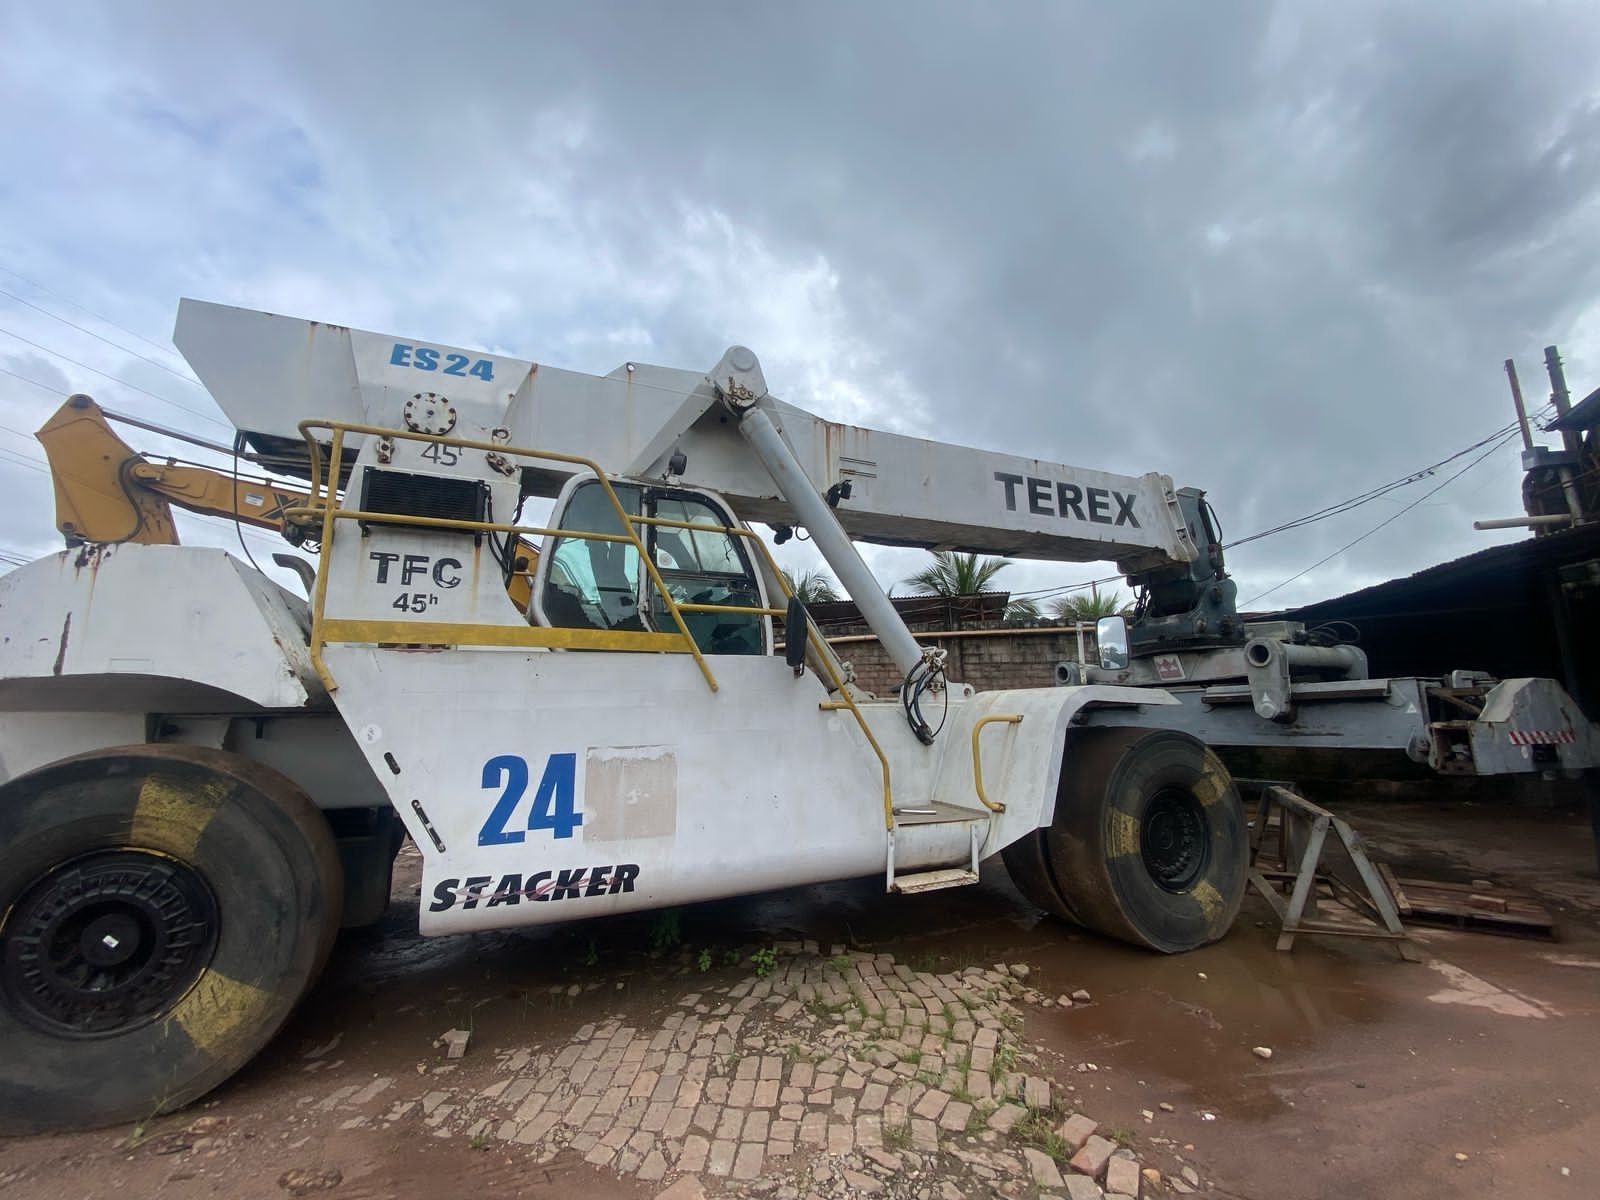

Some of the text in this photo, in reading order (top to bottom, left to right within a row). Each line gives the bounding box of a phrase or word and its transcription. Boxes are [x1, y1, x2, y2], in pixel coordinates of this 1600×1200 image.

[994, 472, 1142, 529] TEREX
[369, 551, 463, 589] TFC
[478, 753, 583, 847] 24
[429, 863, 641, 912] STACKER
